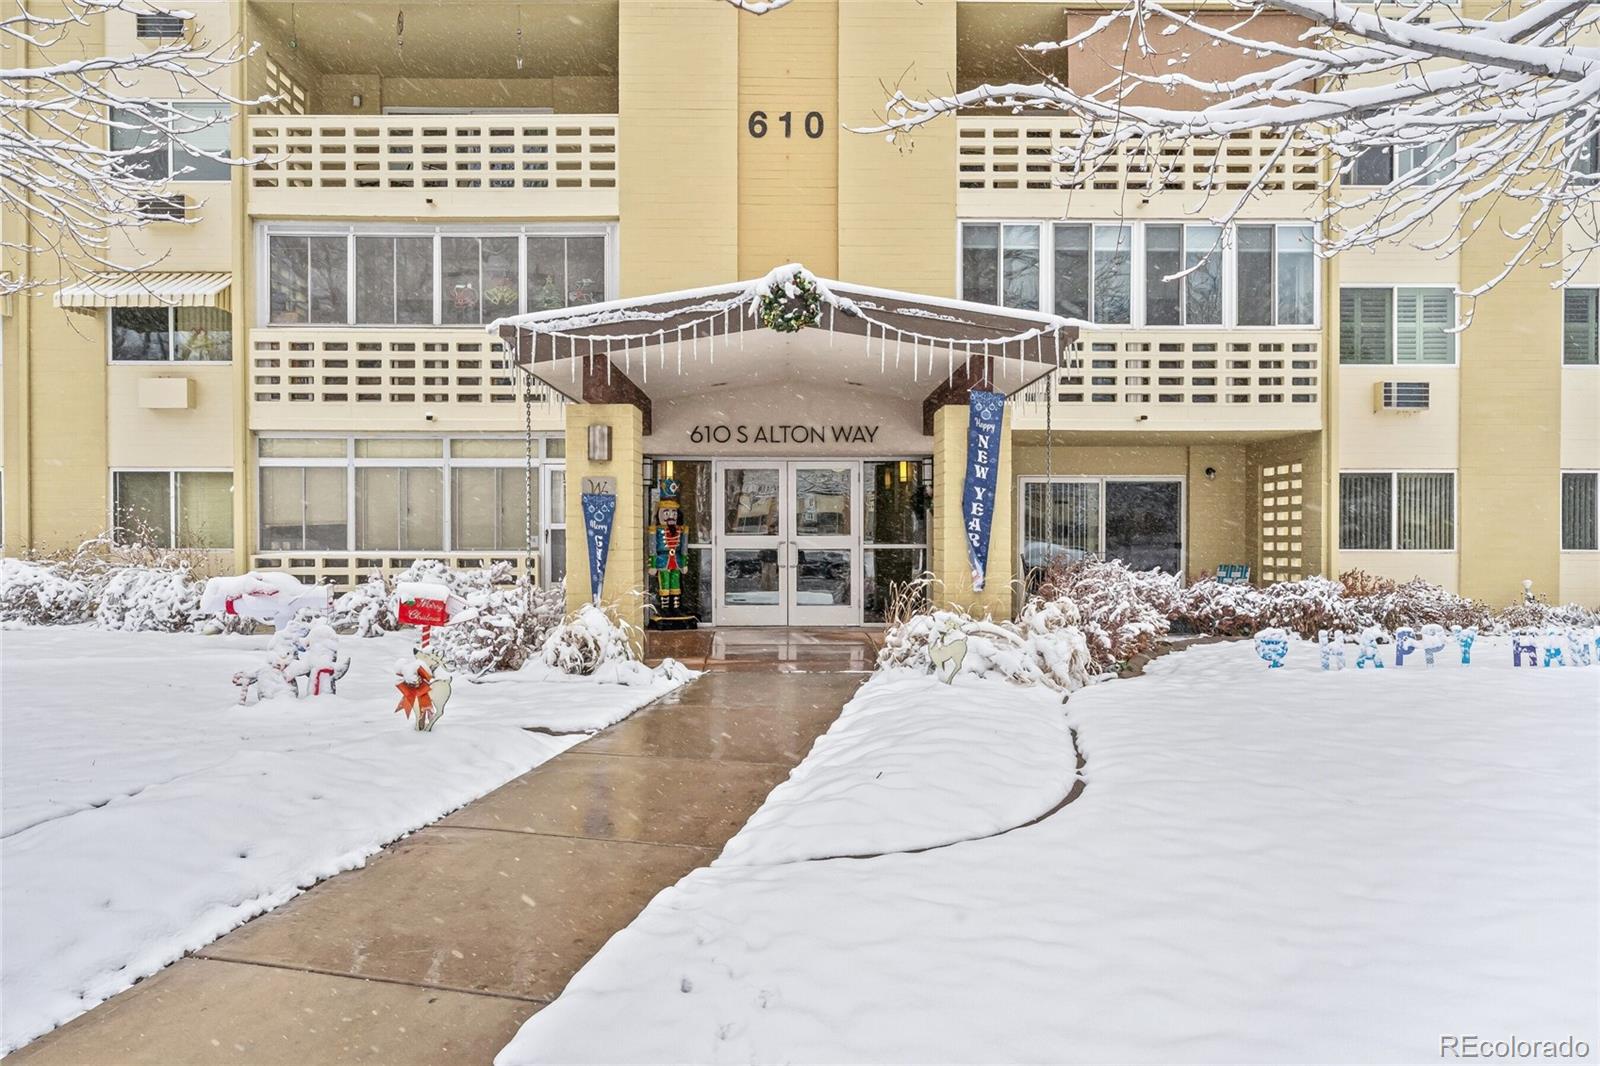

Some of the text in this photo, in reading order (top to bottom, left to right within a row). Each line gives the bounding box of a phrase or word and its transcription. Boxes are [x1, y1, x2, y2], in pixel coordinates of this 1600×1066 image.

[748, 110, 824, 139] 610
[690, 425, 879, 443] 610 S ALTON WAY
[974, 417, 996, 434] Happy
[974, 434, 990, 480] NEW
[590, 519, 608, 534] Merry
[968, 486, 987, 547] YEAR
[416, 599, 443, 612] Merry
[1318, 625, 1478, 671] HAPPY
